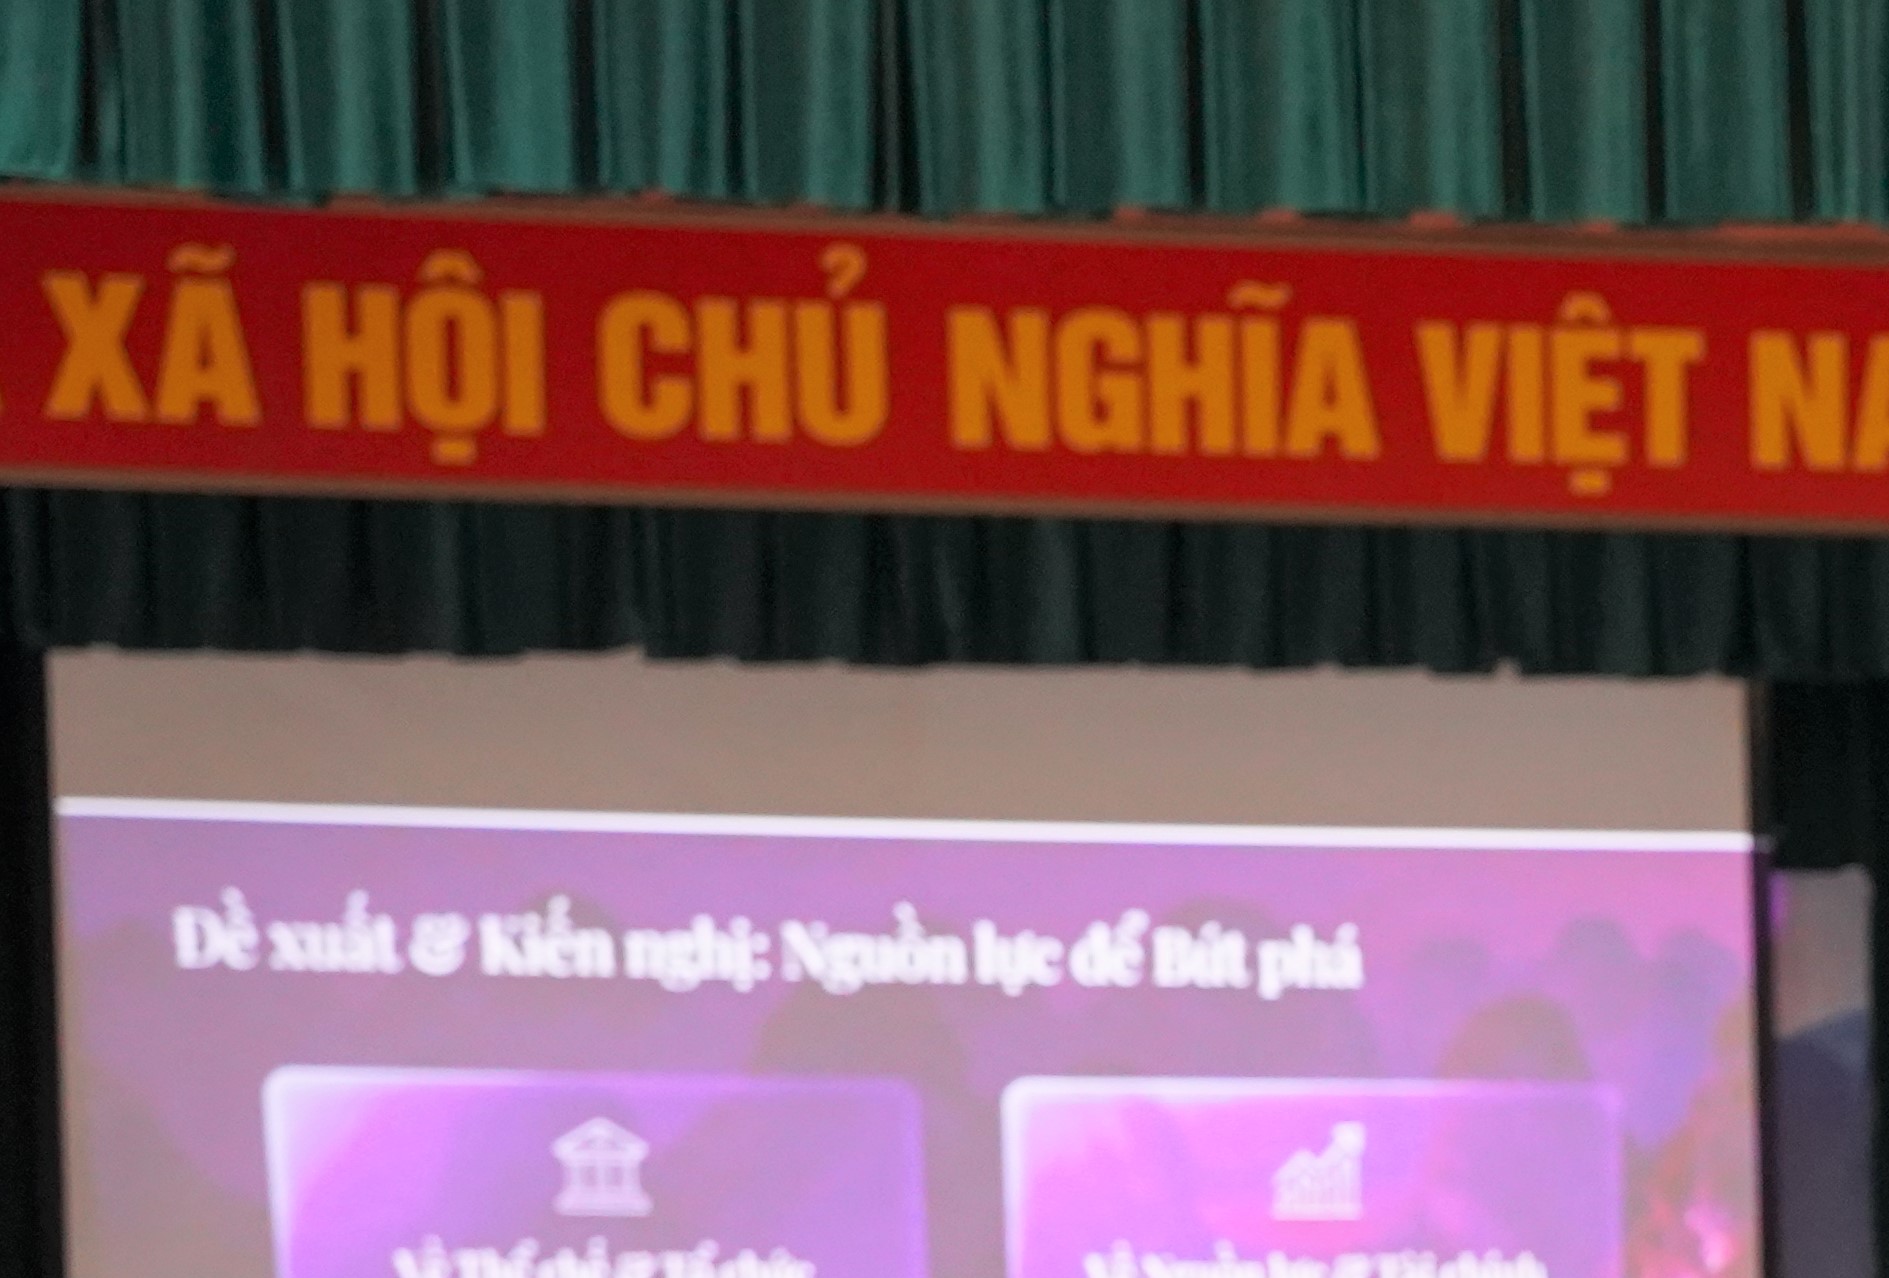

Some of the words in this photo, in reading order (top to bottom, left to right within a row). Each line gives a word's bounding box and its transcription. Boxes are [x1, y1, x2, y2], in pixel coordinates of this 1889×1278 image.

[50, 243, 257, 420] XÃ
[306, 250, 544, 463] HỘI
[597, 246, 888, 443] CHỦ
[949, 283, 1378, 457] NGHĨA
[1417, 293, 1702, 494] VIỆT
